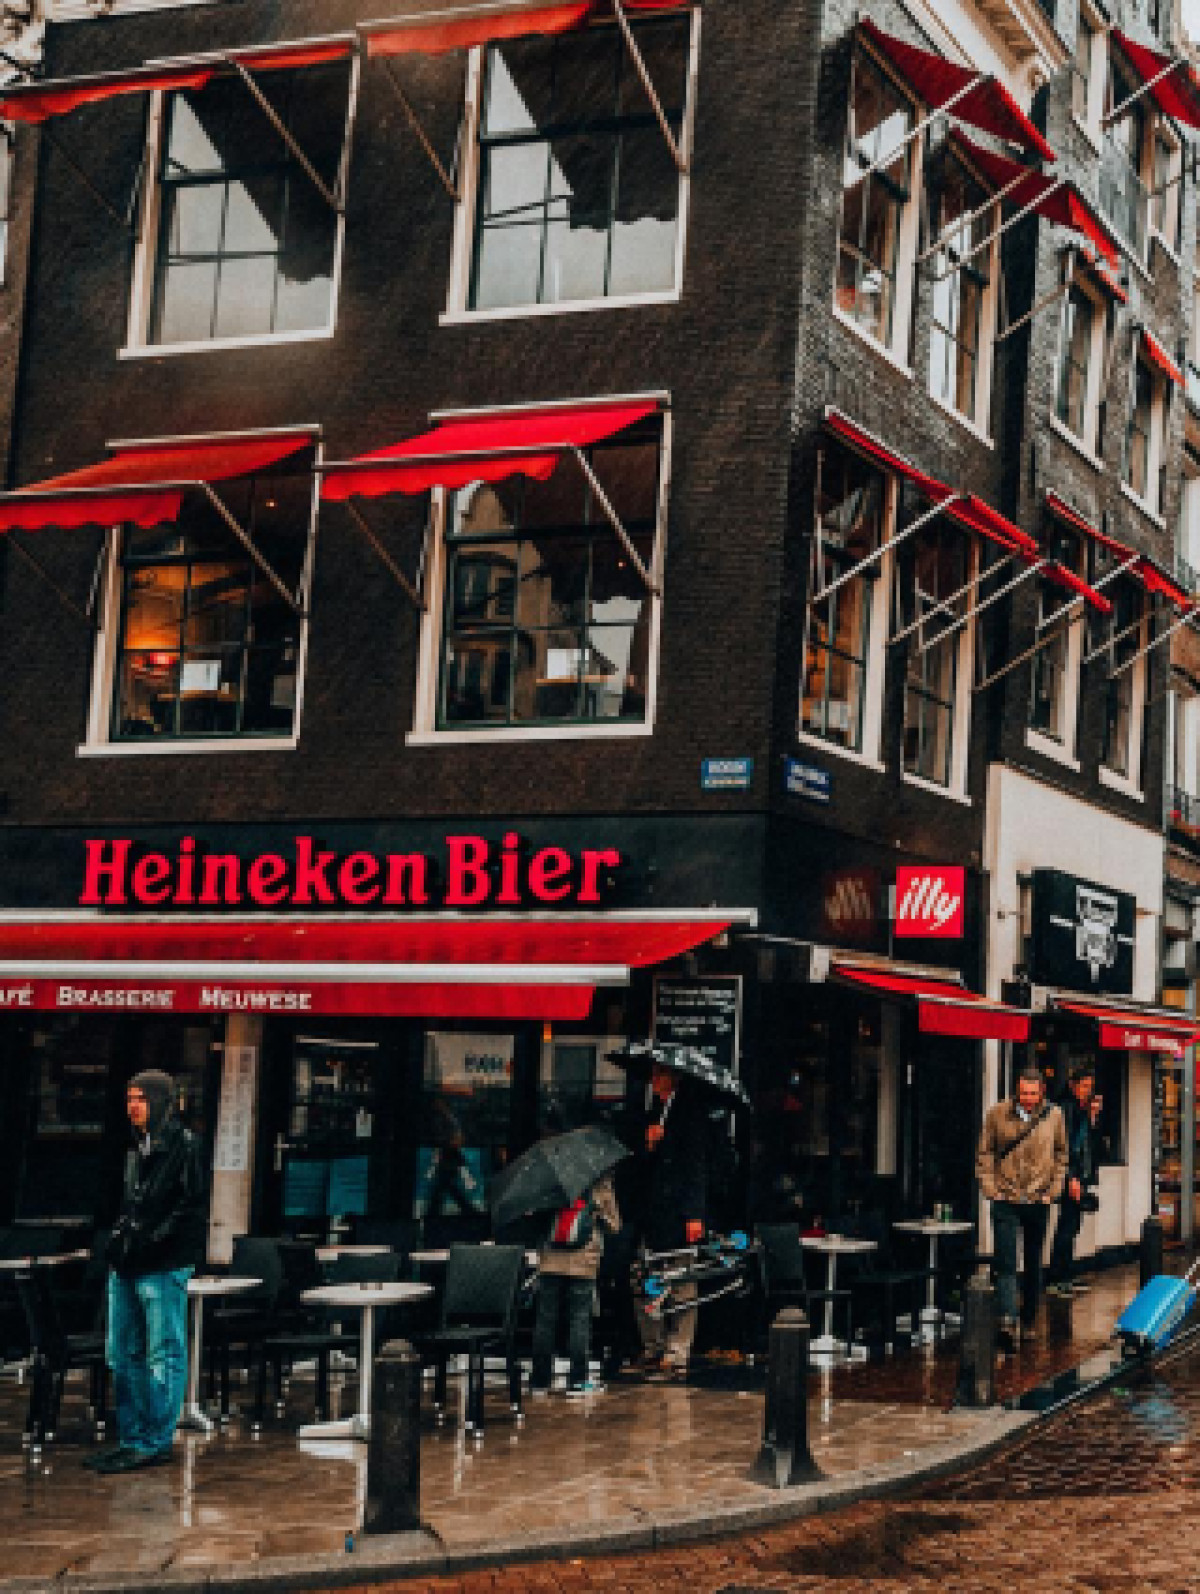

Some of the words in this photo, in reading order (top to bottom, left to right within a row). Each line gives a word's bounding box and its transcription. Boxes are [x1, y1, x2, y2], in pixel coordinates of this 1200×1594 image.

[78, 836, 427, 905] Heineken
[443, 832, 621, 905] Bier
[899, 875, 961, 931] illy
[57, 986, 175, 1007] BRASSERIE
